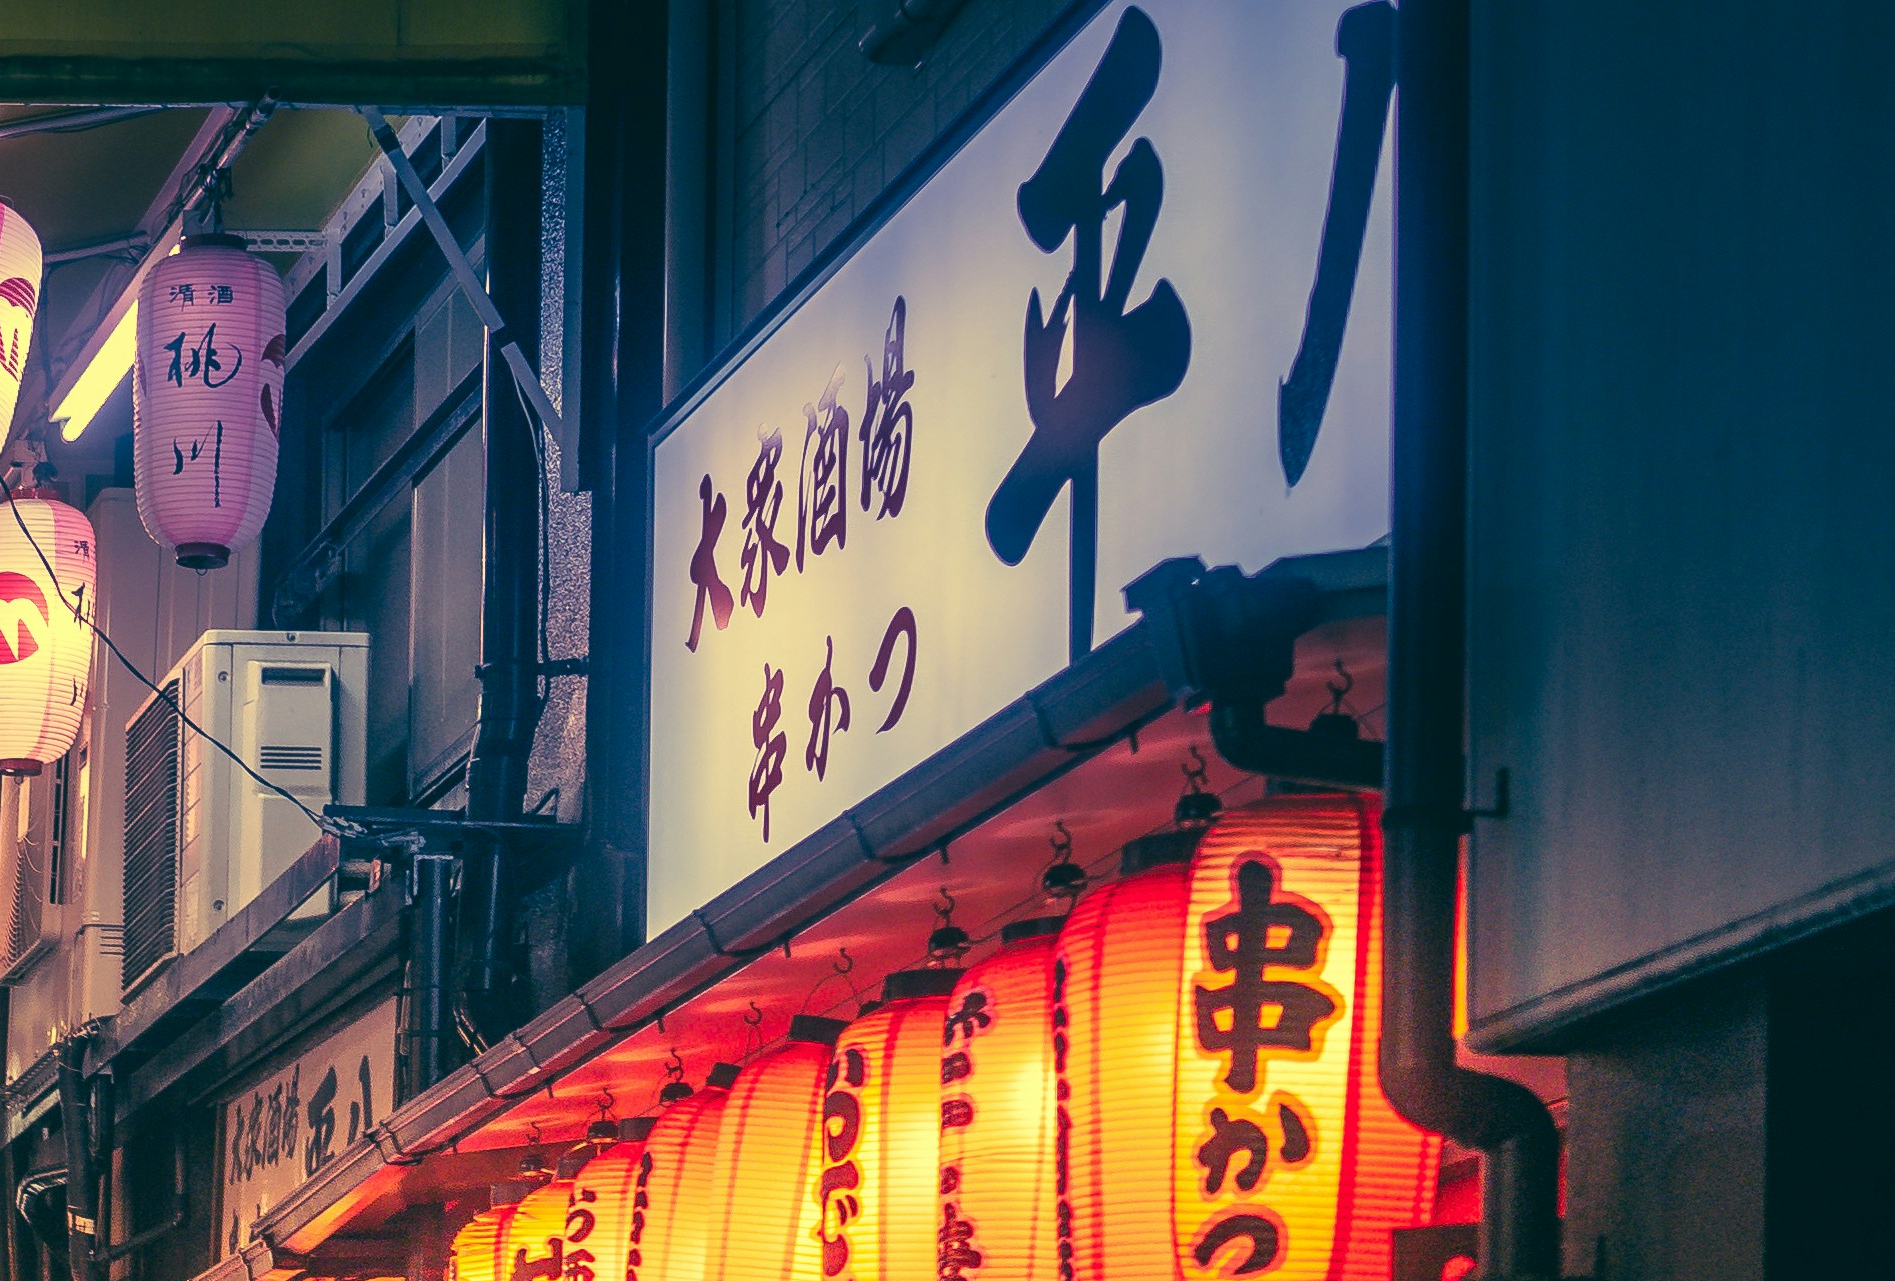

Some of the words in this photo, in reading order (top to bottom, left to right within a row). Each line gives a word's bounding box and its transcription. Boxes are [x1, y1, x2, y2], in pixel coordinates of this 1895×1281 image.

[169, 283, 234, 306] 清酒
[167, 323, 243, 509] 桃川
[684, 295, 915, 653] 大衆酒場
[746, 605, 918, 844] 串かつ
[1194, 858, 1343, 1276] 串かつ
